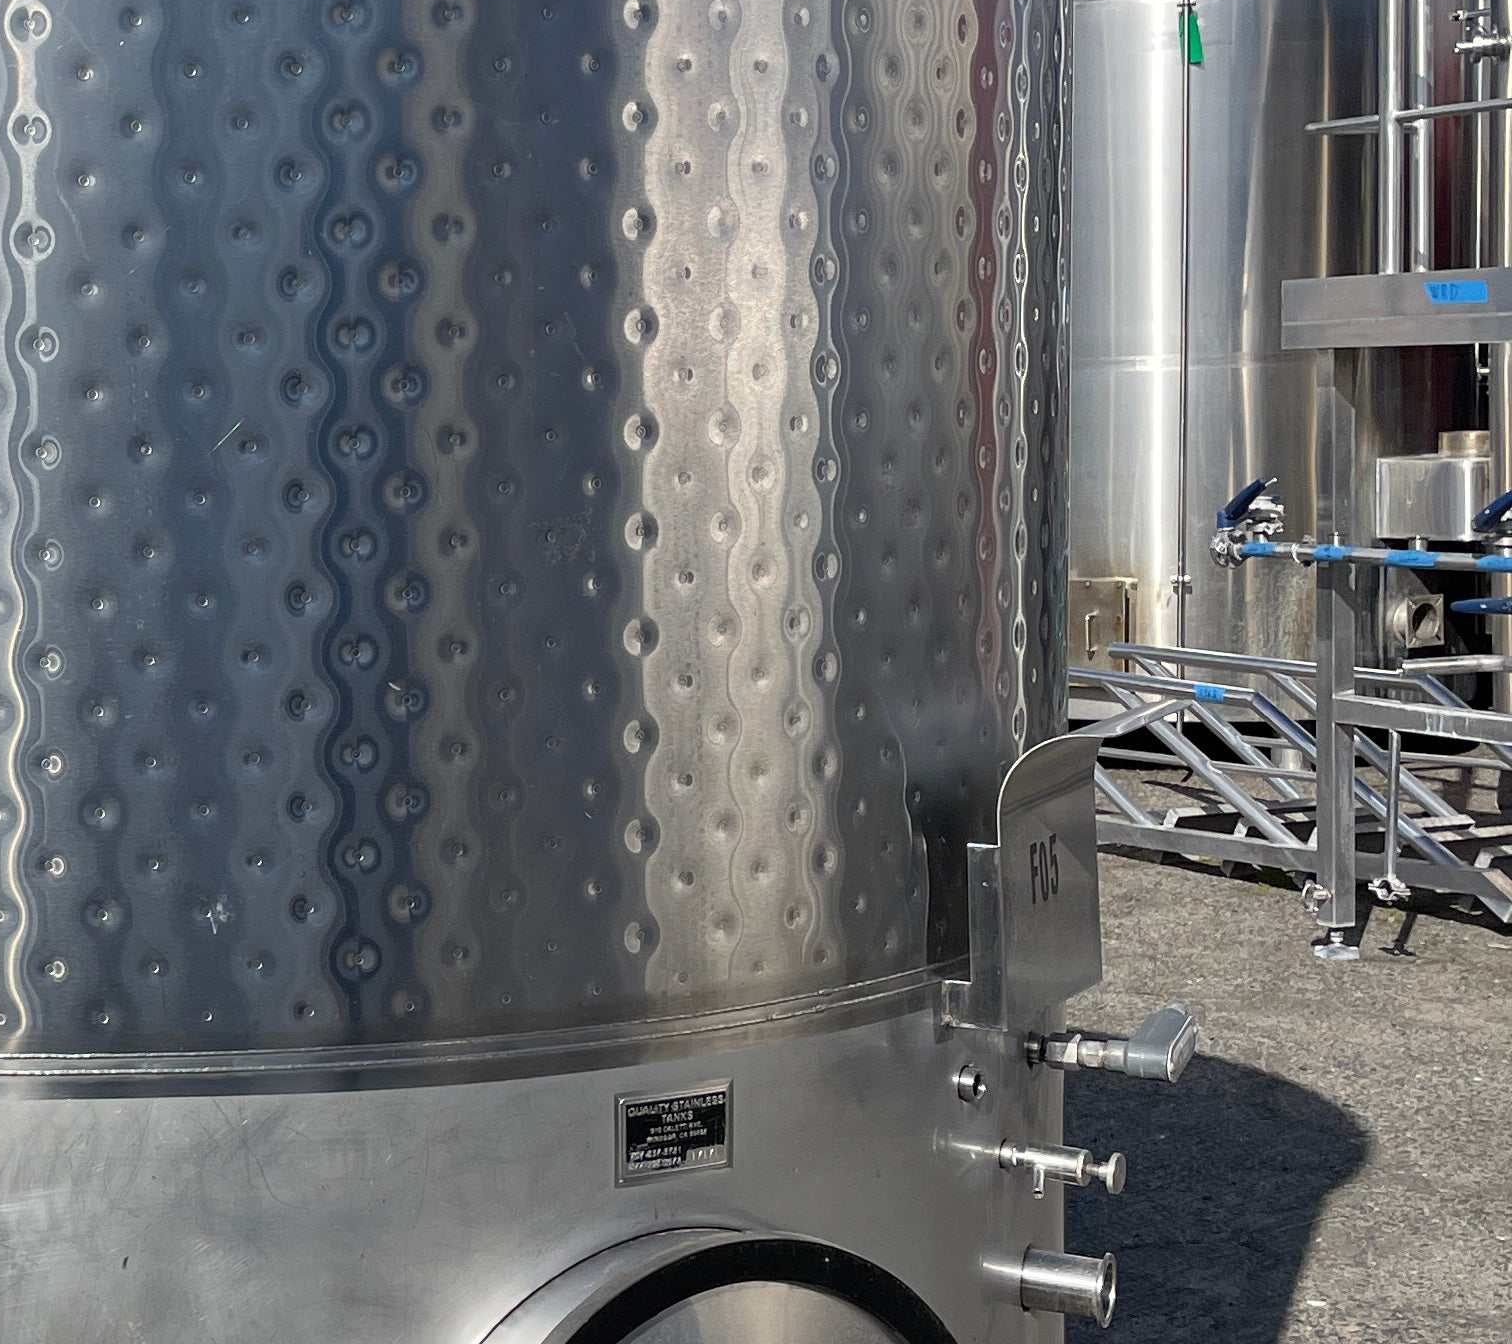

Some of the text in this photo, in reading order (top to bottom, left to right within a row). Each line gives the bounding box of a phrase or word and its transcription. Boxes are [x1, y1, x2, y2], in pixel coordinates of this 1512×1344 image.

[628, 1094, 724, 1117] QUALITY STAINLESS
[661, 1110, 694, 1124] TANKS
